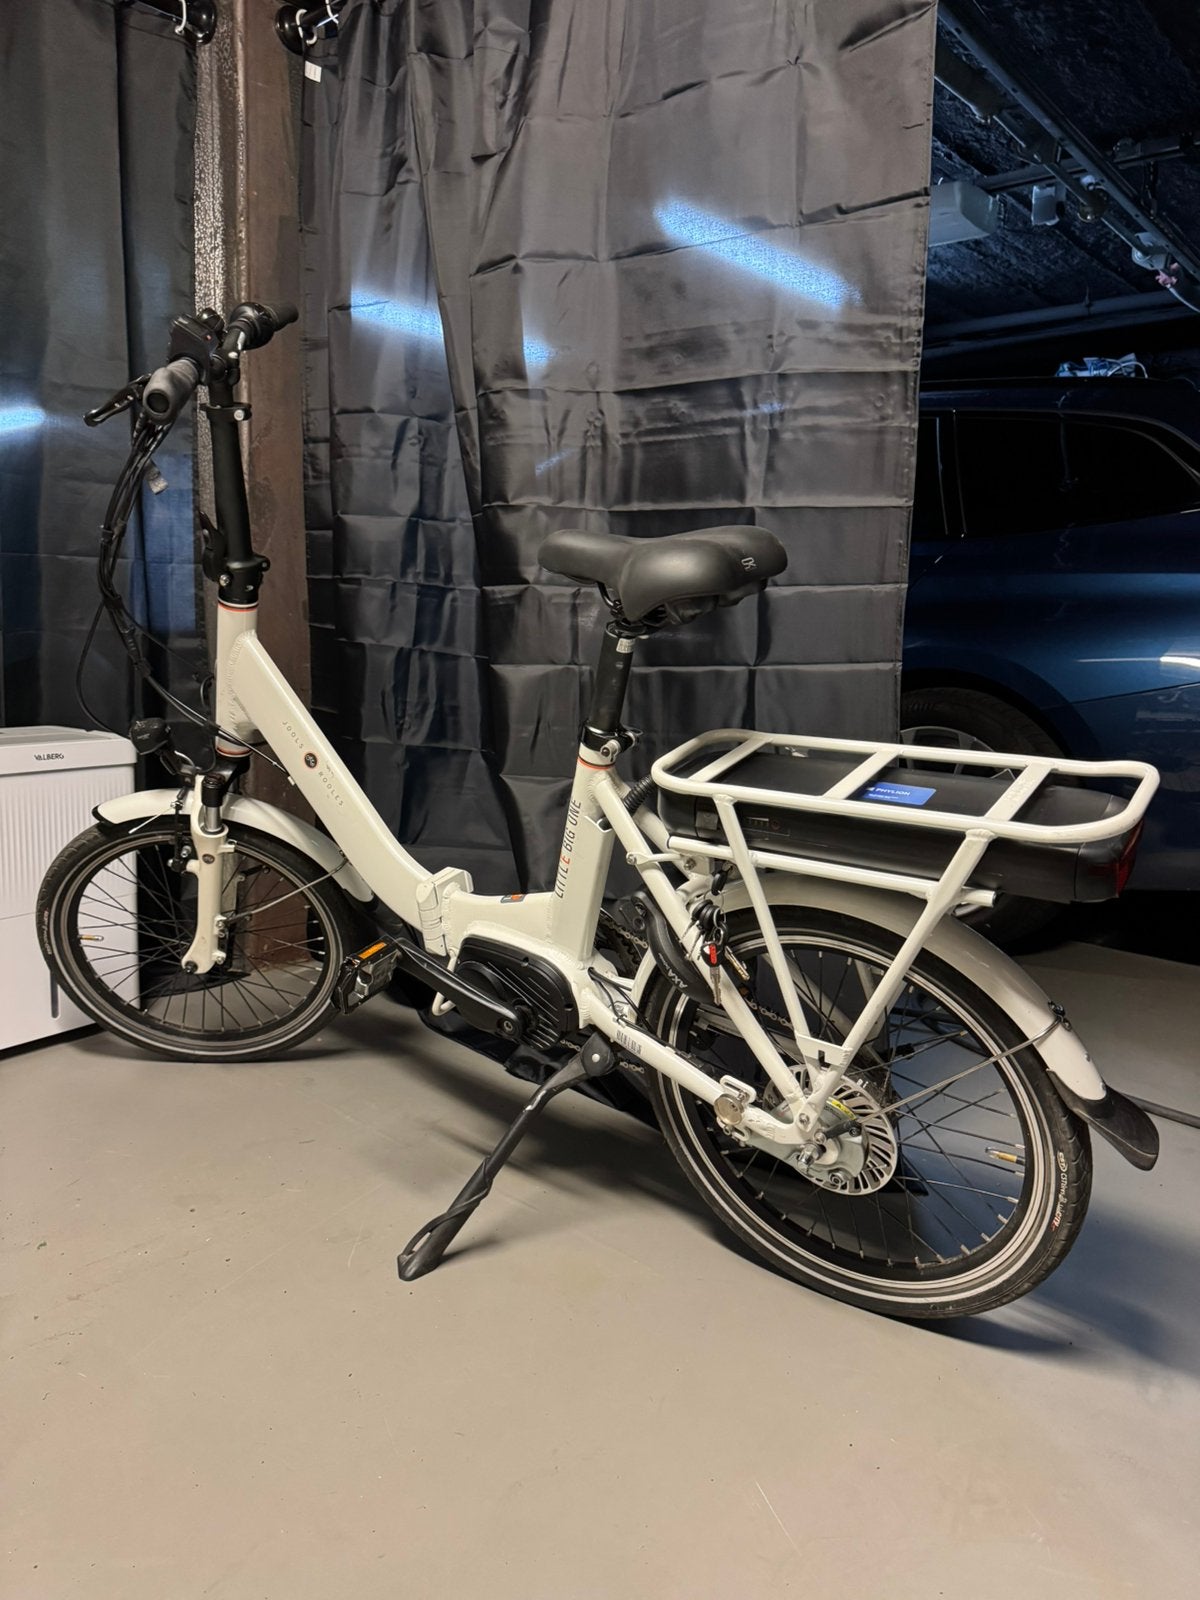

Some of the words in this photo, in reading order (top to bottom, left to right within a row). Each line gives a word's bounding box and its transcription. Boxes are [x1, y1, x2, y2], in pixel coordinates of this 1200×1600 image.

[282, 721, 304, 749] JOOLS
[34, 753, 65, 761] VALBERG
[568, 800, 582, 826] ONE
[563, 827, 576, 853] BIG
[668, 969, 688, 988] AXA
